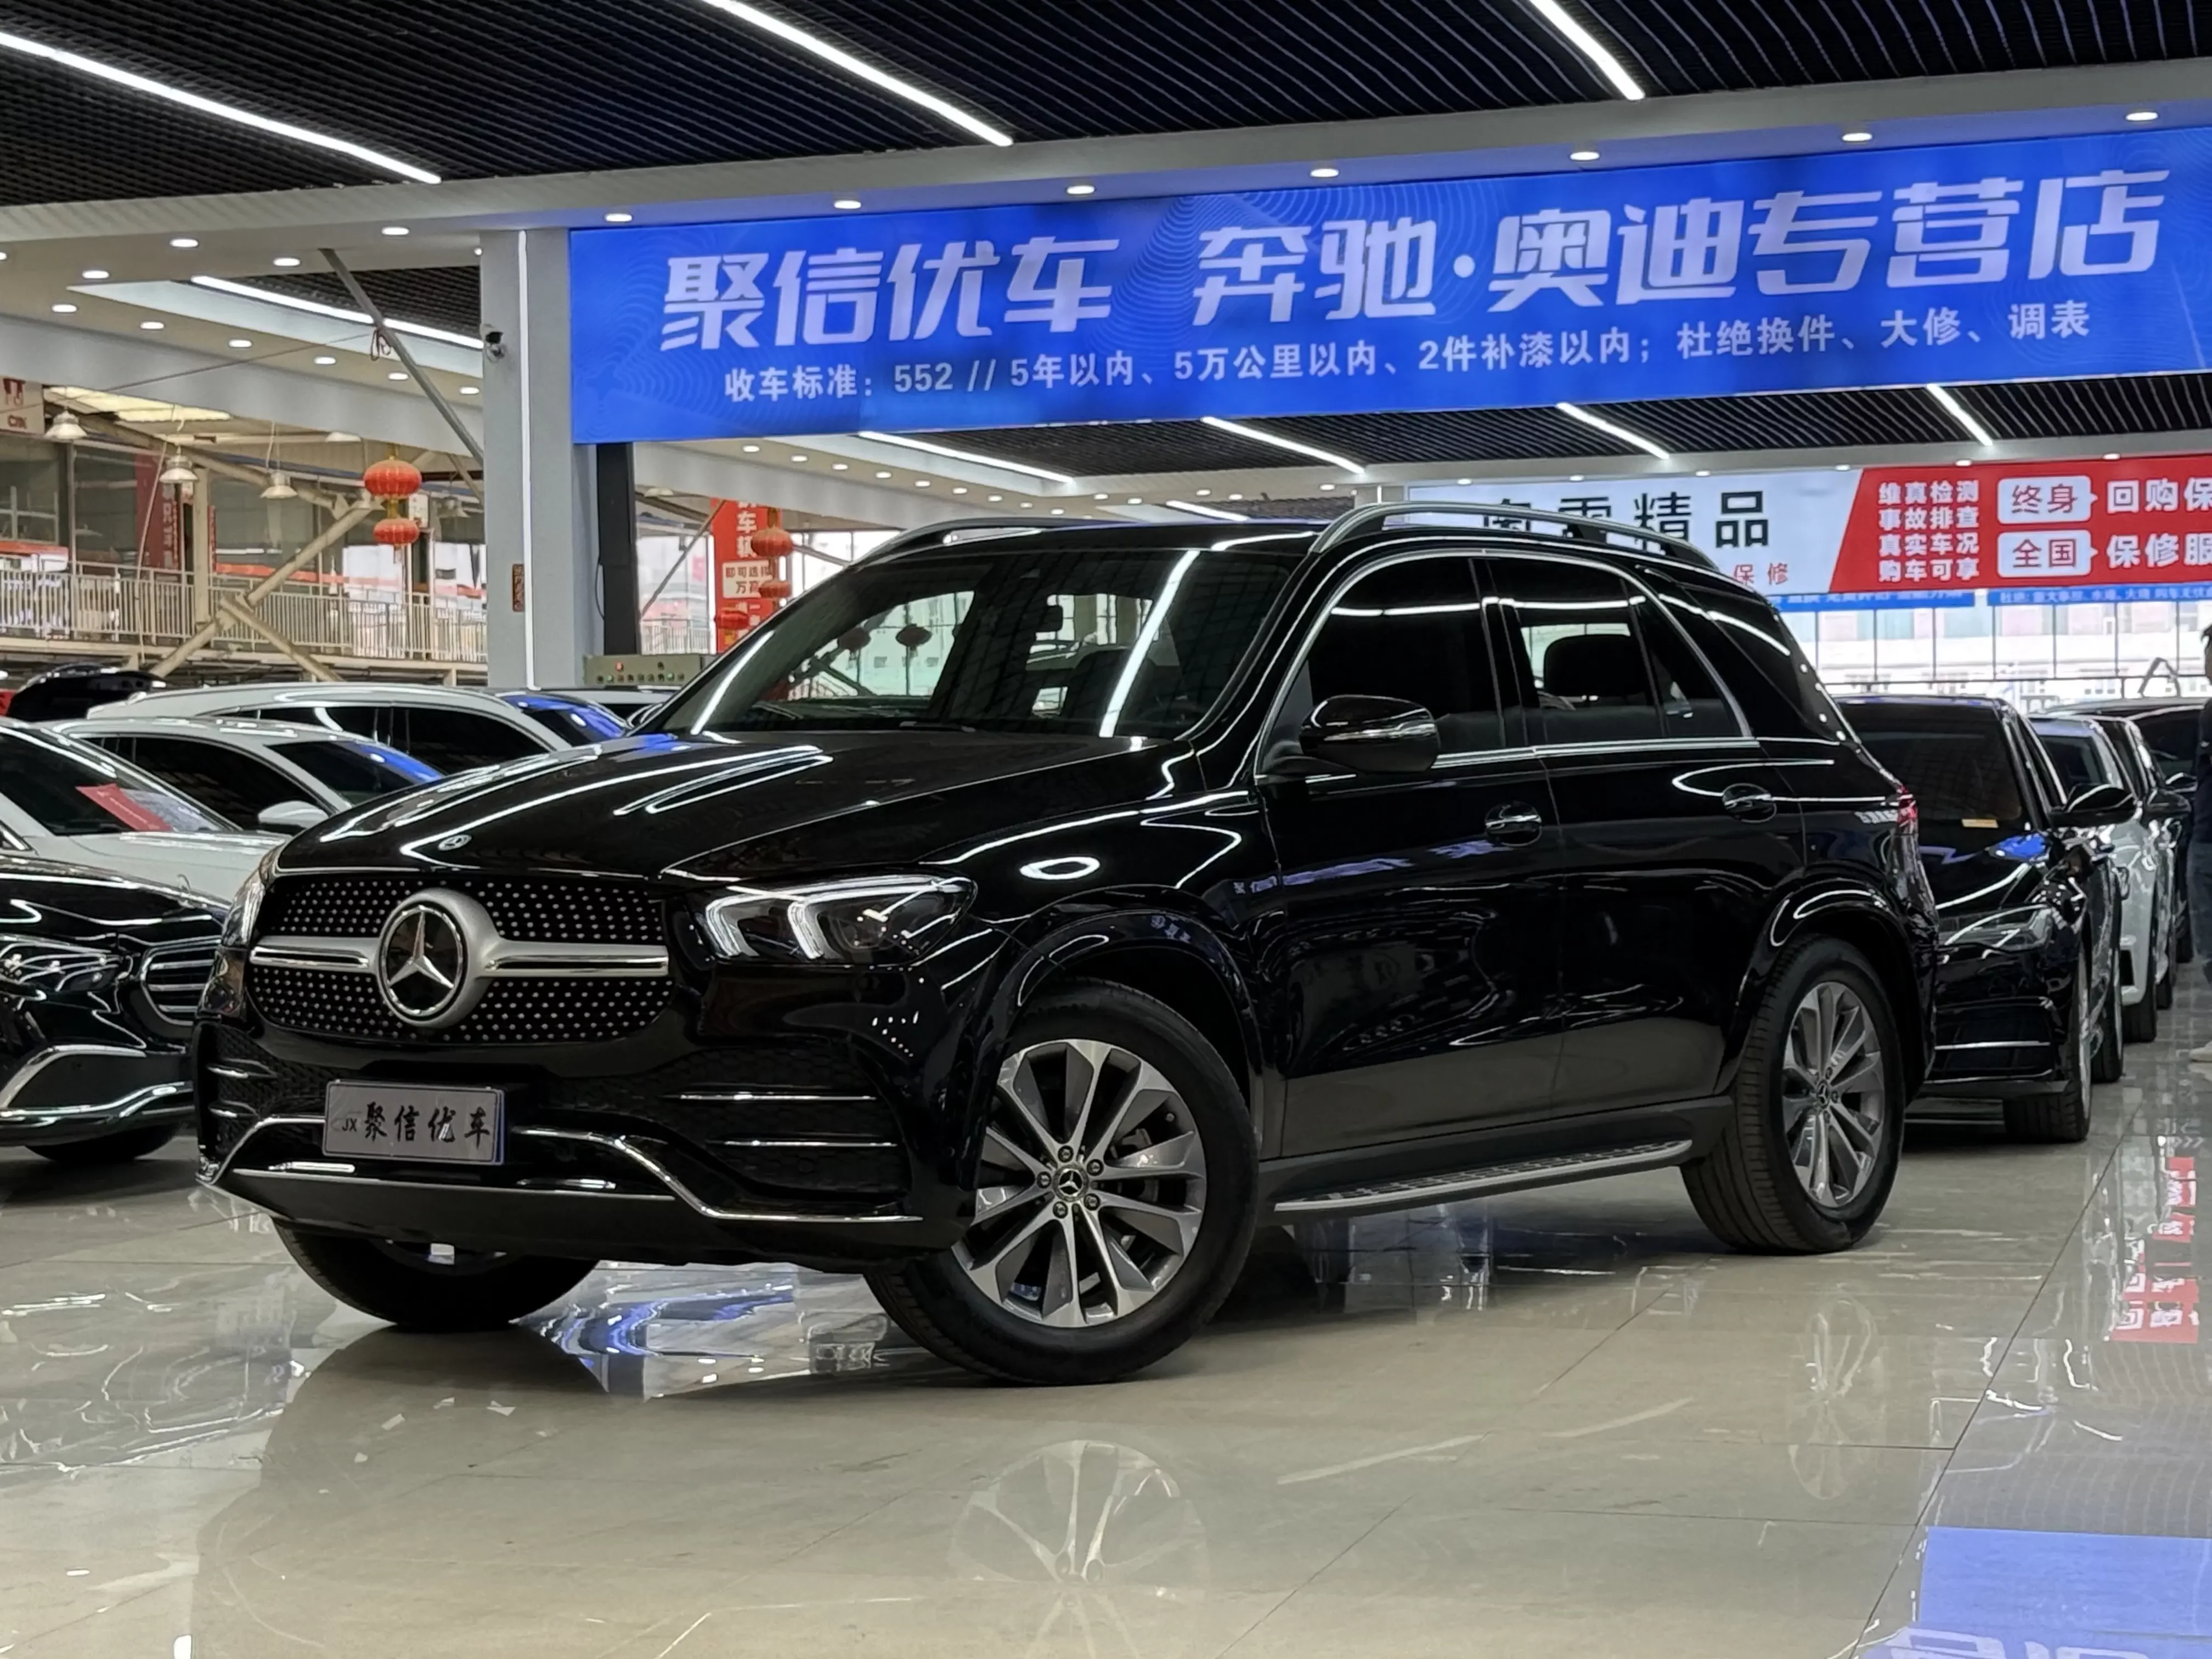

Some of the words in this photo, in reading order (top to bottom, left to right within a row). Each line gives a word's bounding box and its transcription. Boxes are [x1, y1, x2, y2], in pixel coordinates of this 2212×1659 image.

[660, 236, 1120, 352] 聚信优车
[1193, 169, 2170, 326] 奔驰·奥迪专营店
[2012, 483, 2078, 514] 终身
[1878, 532, 1979, 557] 真实车况
[2012, 538, 2077, 568] 全国
[342, 1118, 357, 1132] JX
[364, 1101, 490, 1149] 聚信优车
